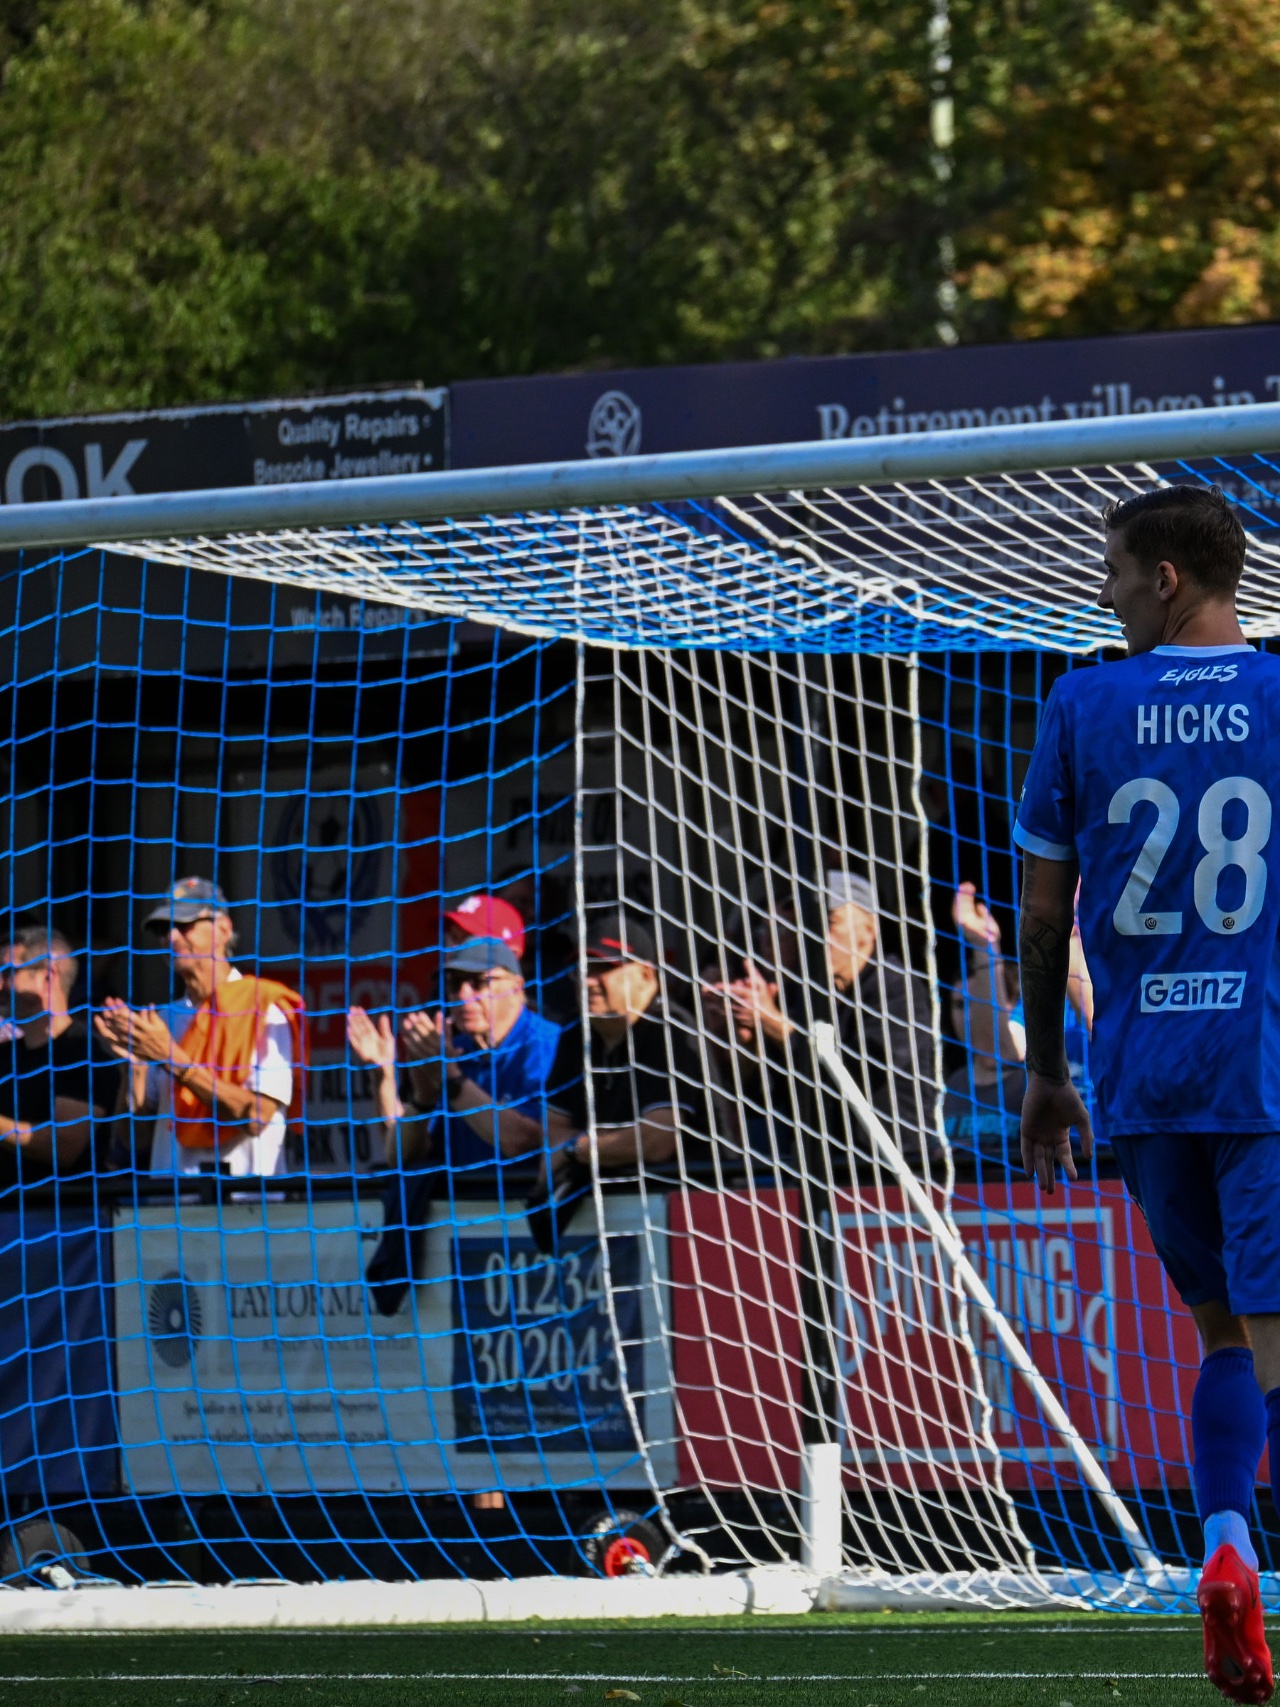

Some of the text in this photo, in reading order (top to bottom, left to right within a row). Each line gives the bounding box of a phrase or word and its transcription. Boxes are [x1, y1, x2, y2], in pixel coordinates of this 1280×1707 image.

[278, 410, 420, 449] Quality Repairs
[816, 395, 1058, 440] Retirement
[5, 438, 148, 504] OK
[1159, 664, 1239, 687] EAGLES
[1136, 703, 1250, 745] HICKS
[1107, 776, 1273, 936] 28
[1144, 977, 1243, 1007] Gainz
[228, 1281, 410, 1319] TAYLORMA
[484, 1251, 611, 1317] 01234
[471, 1326, 623, 1393] 302043
